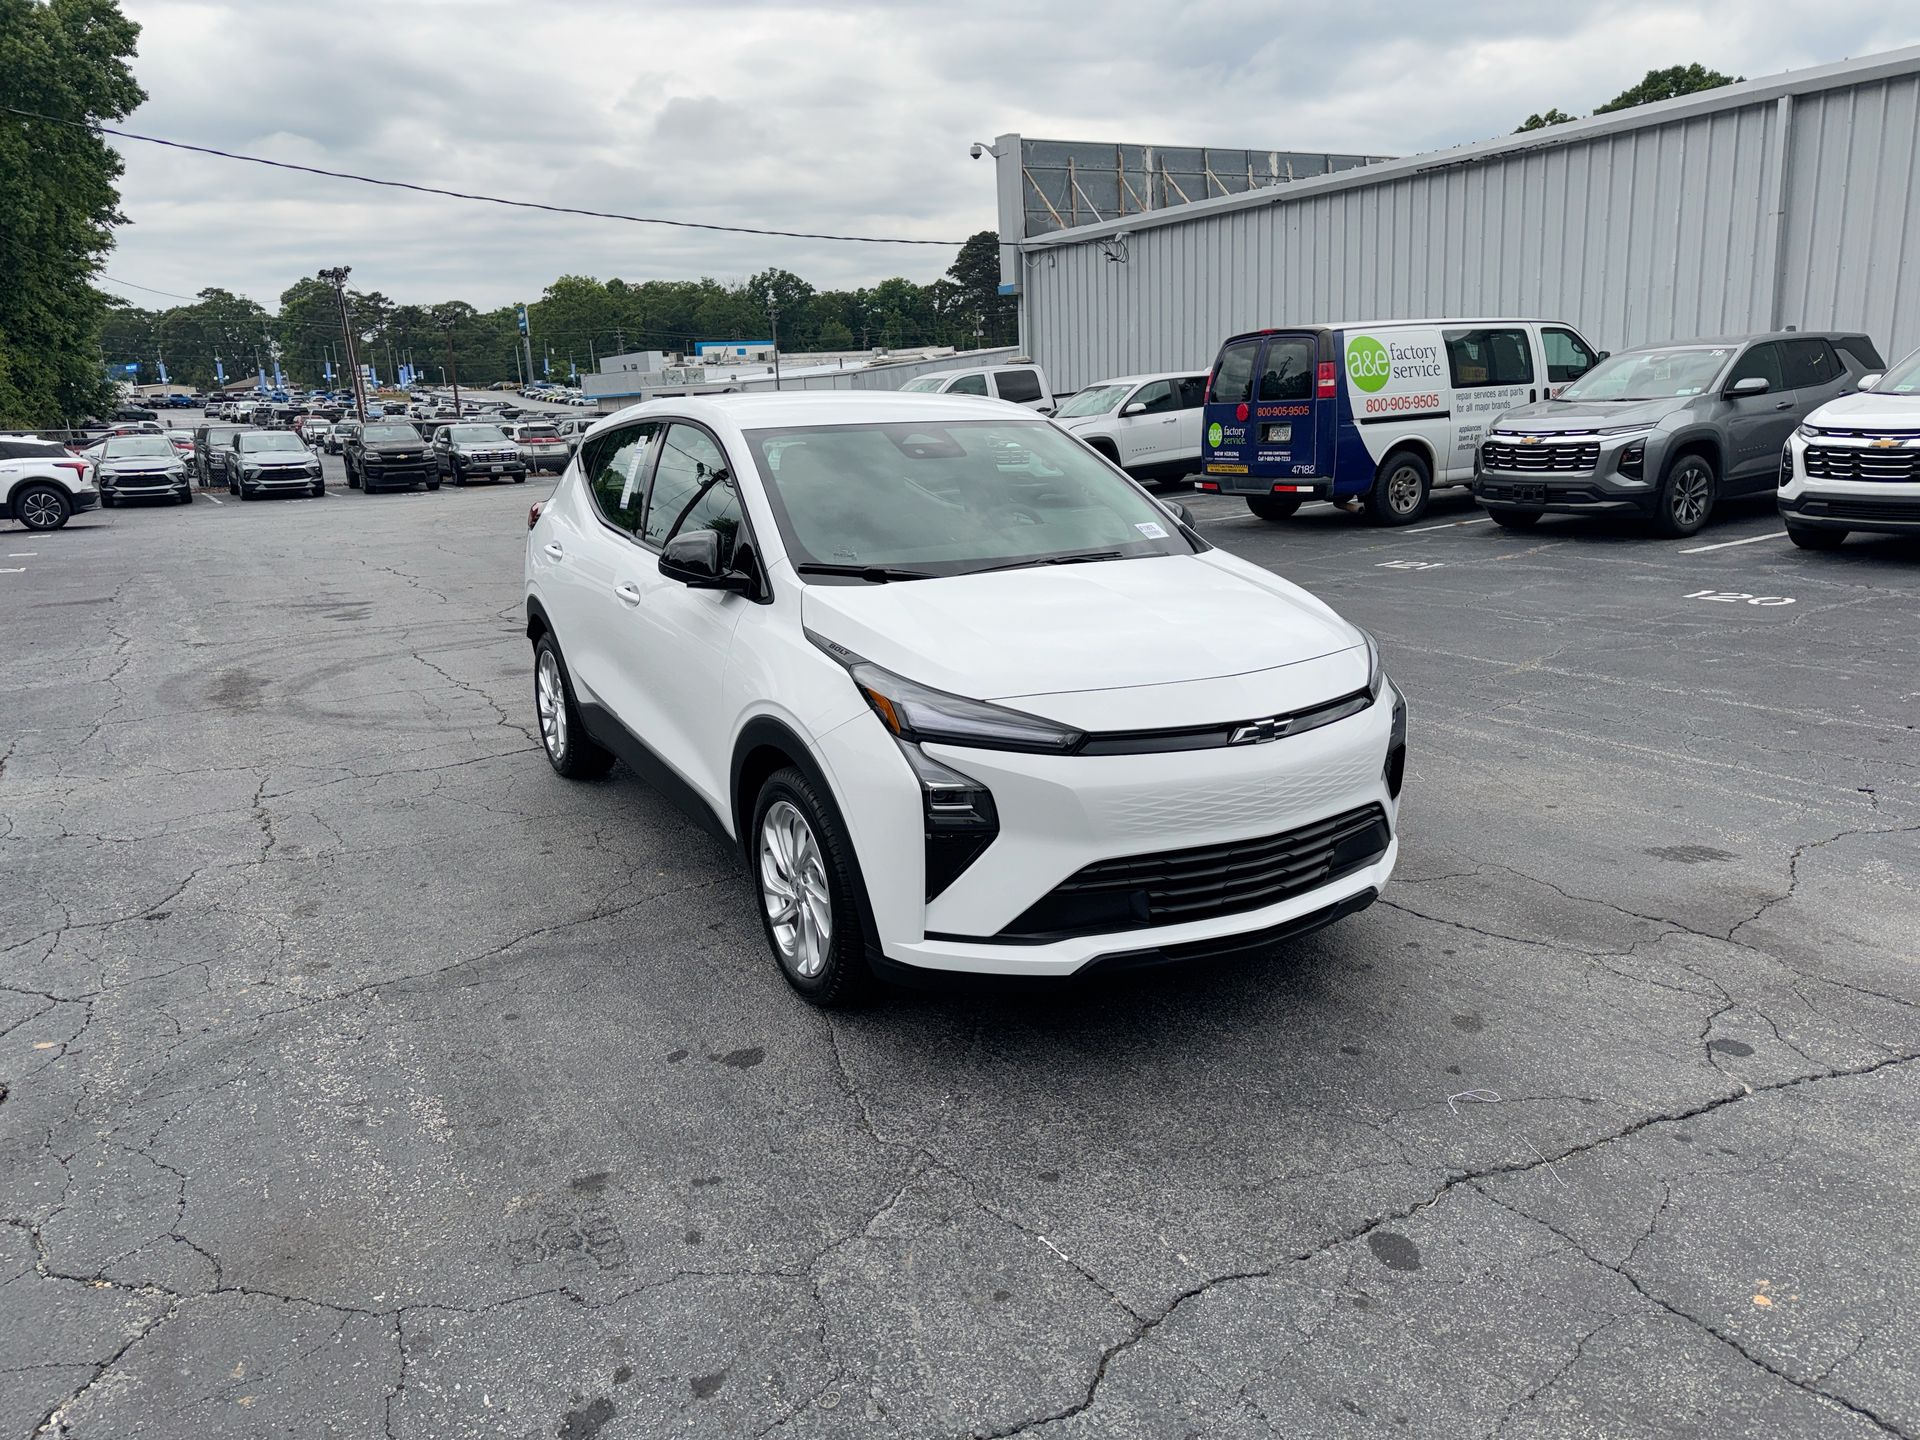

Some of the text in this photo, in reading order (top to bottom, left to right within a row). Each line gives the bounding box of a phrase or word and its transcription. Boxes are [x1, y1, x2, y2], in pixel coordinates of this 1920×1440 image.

[1390, 343, 1436, 363] factory
[1349, 350, 1388, 377] a&e
[1393, 361, 1440, 379] service
[1456, 388, 1524, 402] repair services and parts
[1475, 402, 1490, 413] major
[1492, 400, 1511, 410] brands
[1224, 425, 1246, 438] factory
[1291, 465, 1315, 475] 47182
[1682, 590, 1797, 606] 120
[828, 643, 850, 656] BOLT
